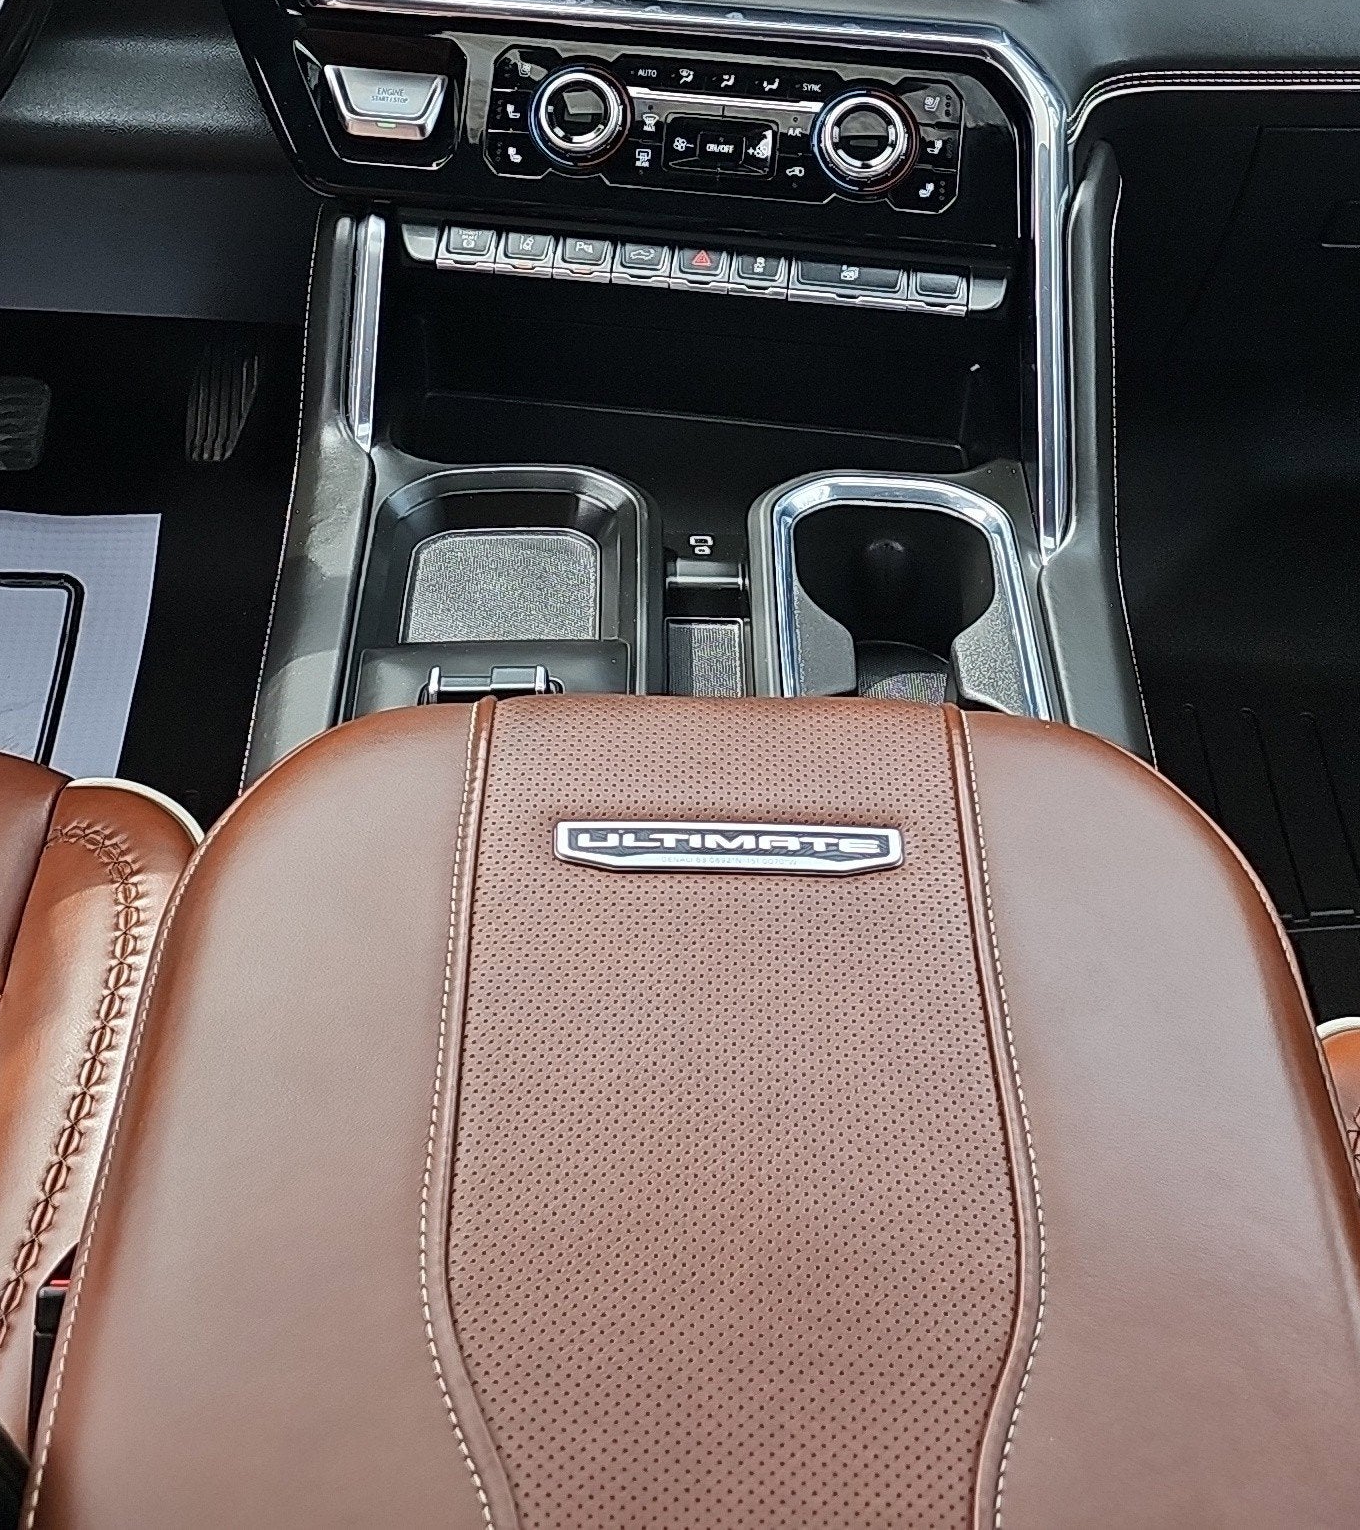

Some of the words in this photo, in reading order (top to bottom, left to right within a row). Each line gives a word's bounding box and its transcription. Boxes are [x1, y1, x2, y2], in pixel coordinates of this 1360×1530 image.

[637, 68, 657, 78] AUTO
[376, 87, 405, 97] ENGINE
[802, 82, 822, 93] SYNC
[787, 127, 802, 138] A/C
[705, 143, 735, 154] ON/OFF
[576, 832, 880, 854] ULTIMATE
